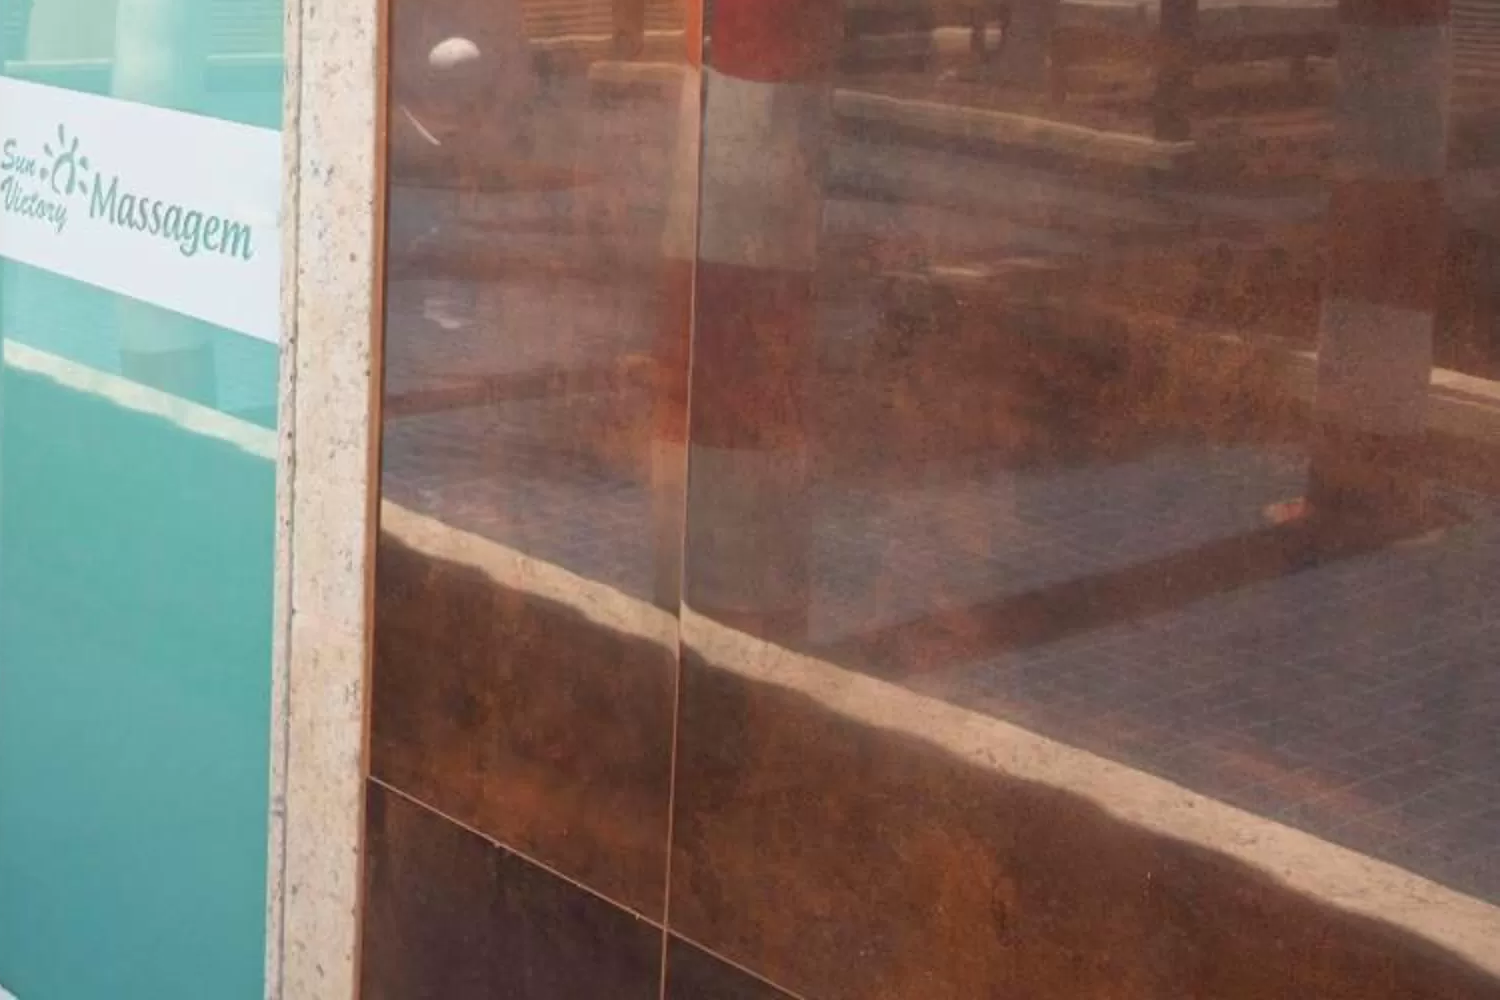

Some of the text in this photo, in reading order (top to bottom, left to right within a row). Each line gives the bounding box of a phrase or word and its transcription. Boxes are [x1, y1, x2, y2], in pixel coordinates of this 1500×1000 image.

[1, 139, 36, 175] Sun
[1, 176, 67, 233] Victory
[89, 173, 253, 261] Massagem
